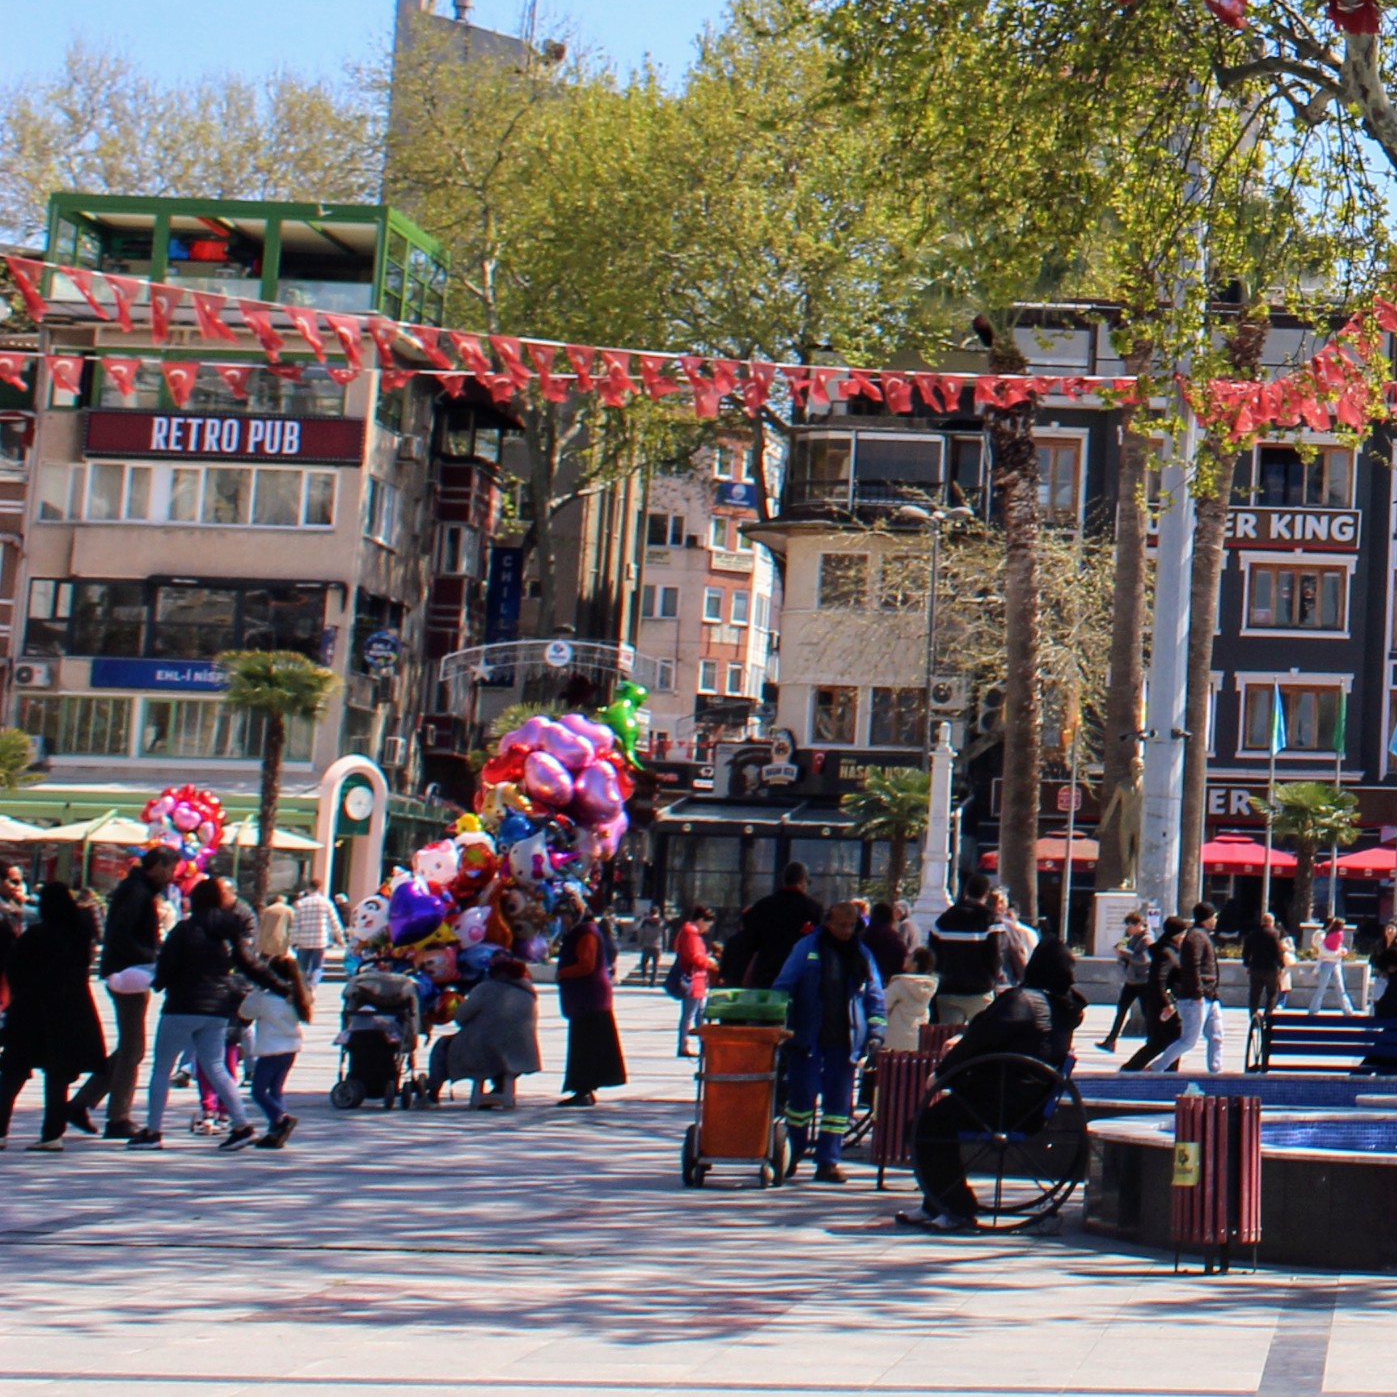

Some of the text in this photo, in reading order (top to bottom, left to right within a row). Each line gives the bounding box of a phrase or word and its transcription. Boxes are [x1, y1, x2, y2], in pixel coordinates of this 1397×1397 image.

[150, 416, 301, 454] RETRO PUB
[1269, 513, 1355, 541] KING
